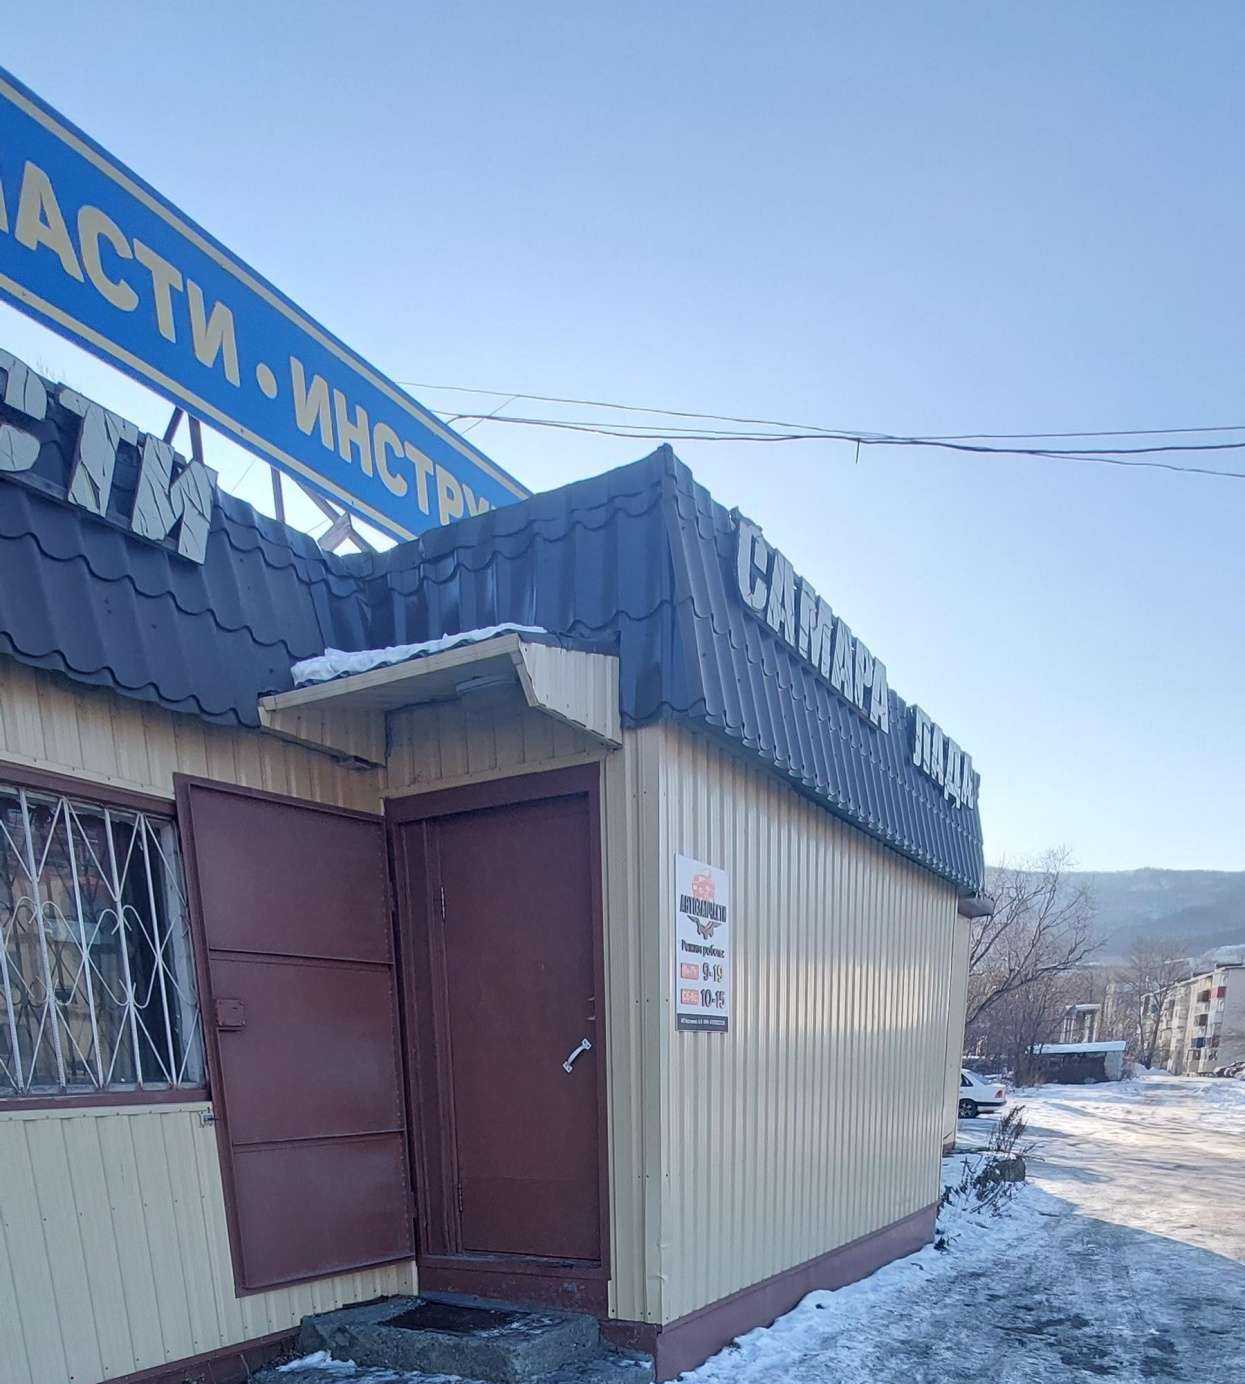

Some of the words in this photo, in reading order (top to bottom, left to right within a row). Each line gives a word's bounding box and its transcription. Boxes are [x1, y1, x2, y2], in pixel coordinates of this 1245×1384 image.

[0, 160, 241, 388] АСТИ
[289, 356, 496, 526] ИНСТР
[737, 518, 890, 735] САМАРА
[913, 705, 975, 810] ЛАДА
[700, 988, 725, 1009] 10-15
